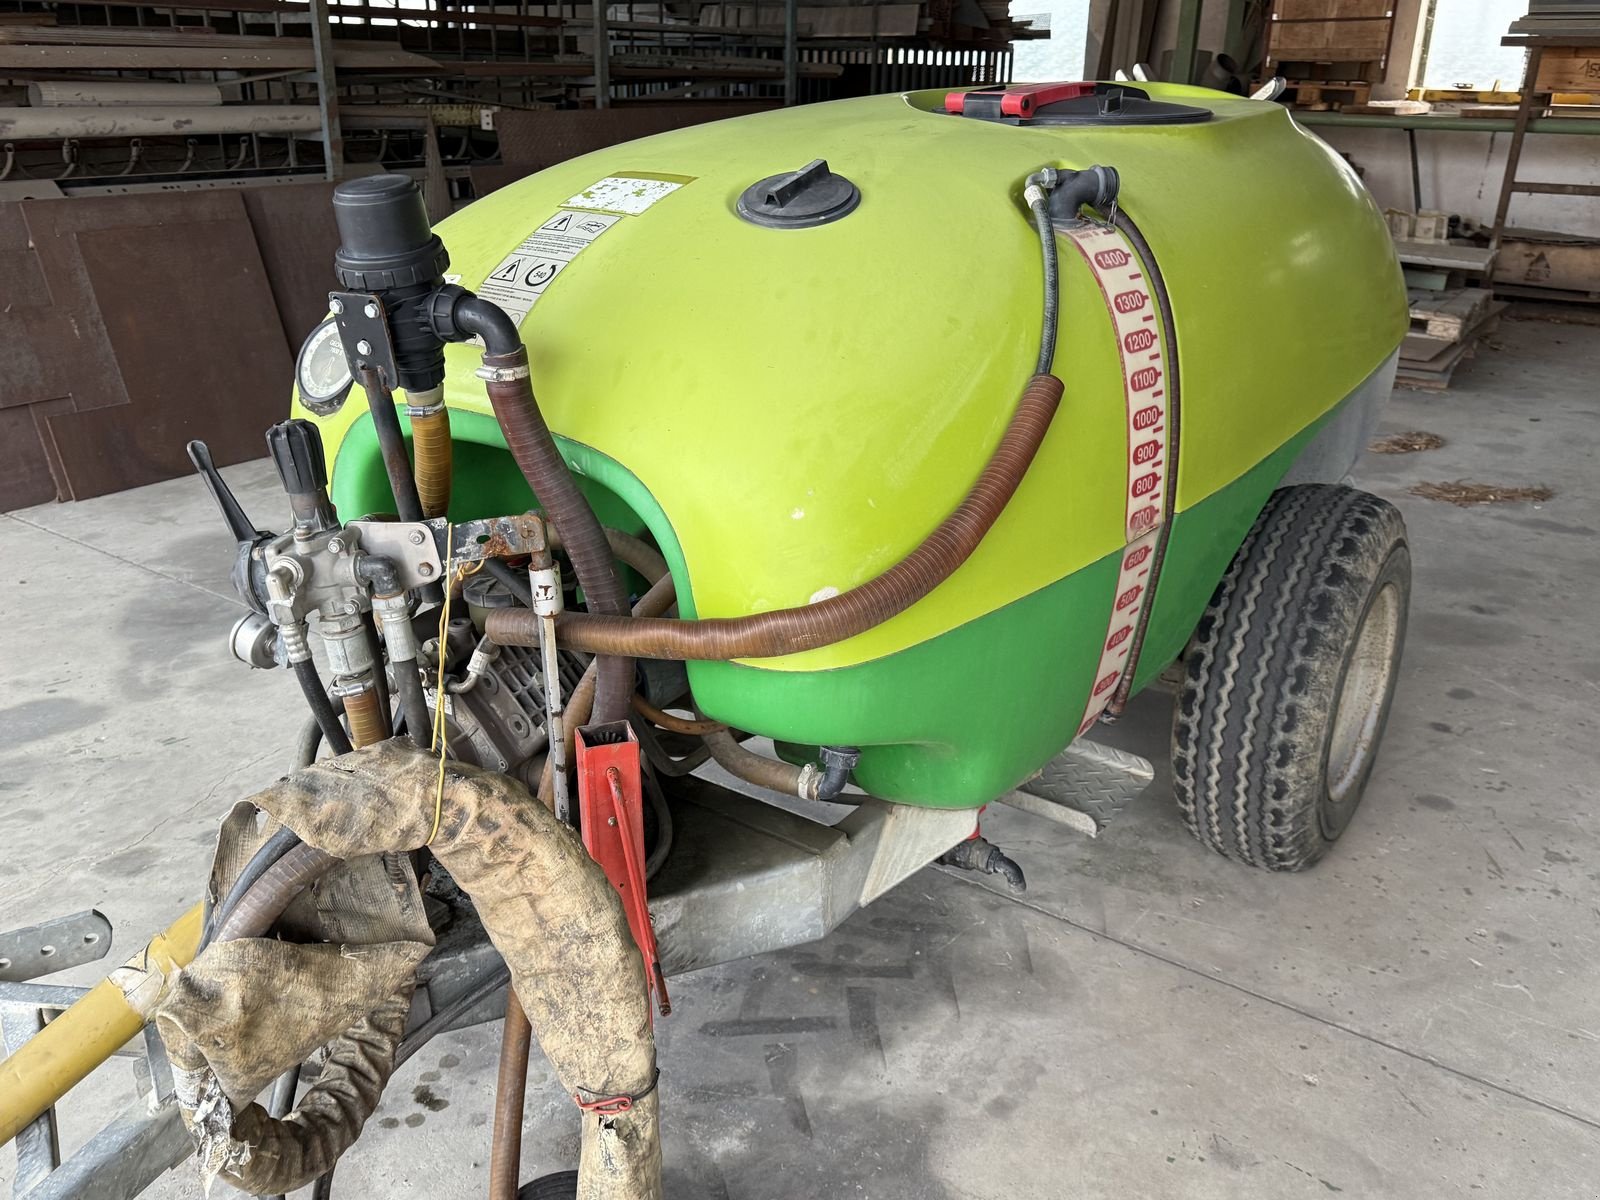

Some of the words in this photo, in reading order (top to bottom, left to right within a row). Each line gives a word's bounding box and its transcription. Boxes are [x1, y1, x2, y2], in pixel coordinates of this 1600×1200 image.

[1579, 59, 1600, 78] 15
[1097, 250, 1126, 268] 1400
[533, 270, 547, 279] 540
[1116, 292, 1143, 312] 1300
[1127, 331, 1151, 351] 1200
[1133, 368, 1155, 390] 1100
[1135, 408, 1158, 429] 1000
[1137, 443, 1155, 463] 900
[1136, 475, 1153, 495] 800
[1134, 508, 1151, 528] 700
[1127, 548, 1145, 568] 600
[1119, 588, 1137, 608] 500
[1110, 628, 1127, 647] 400
